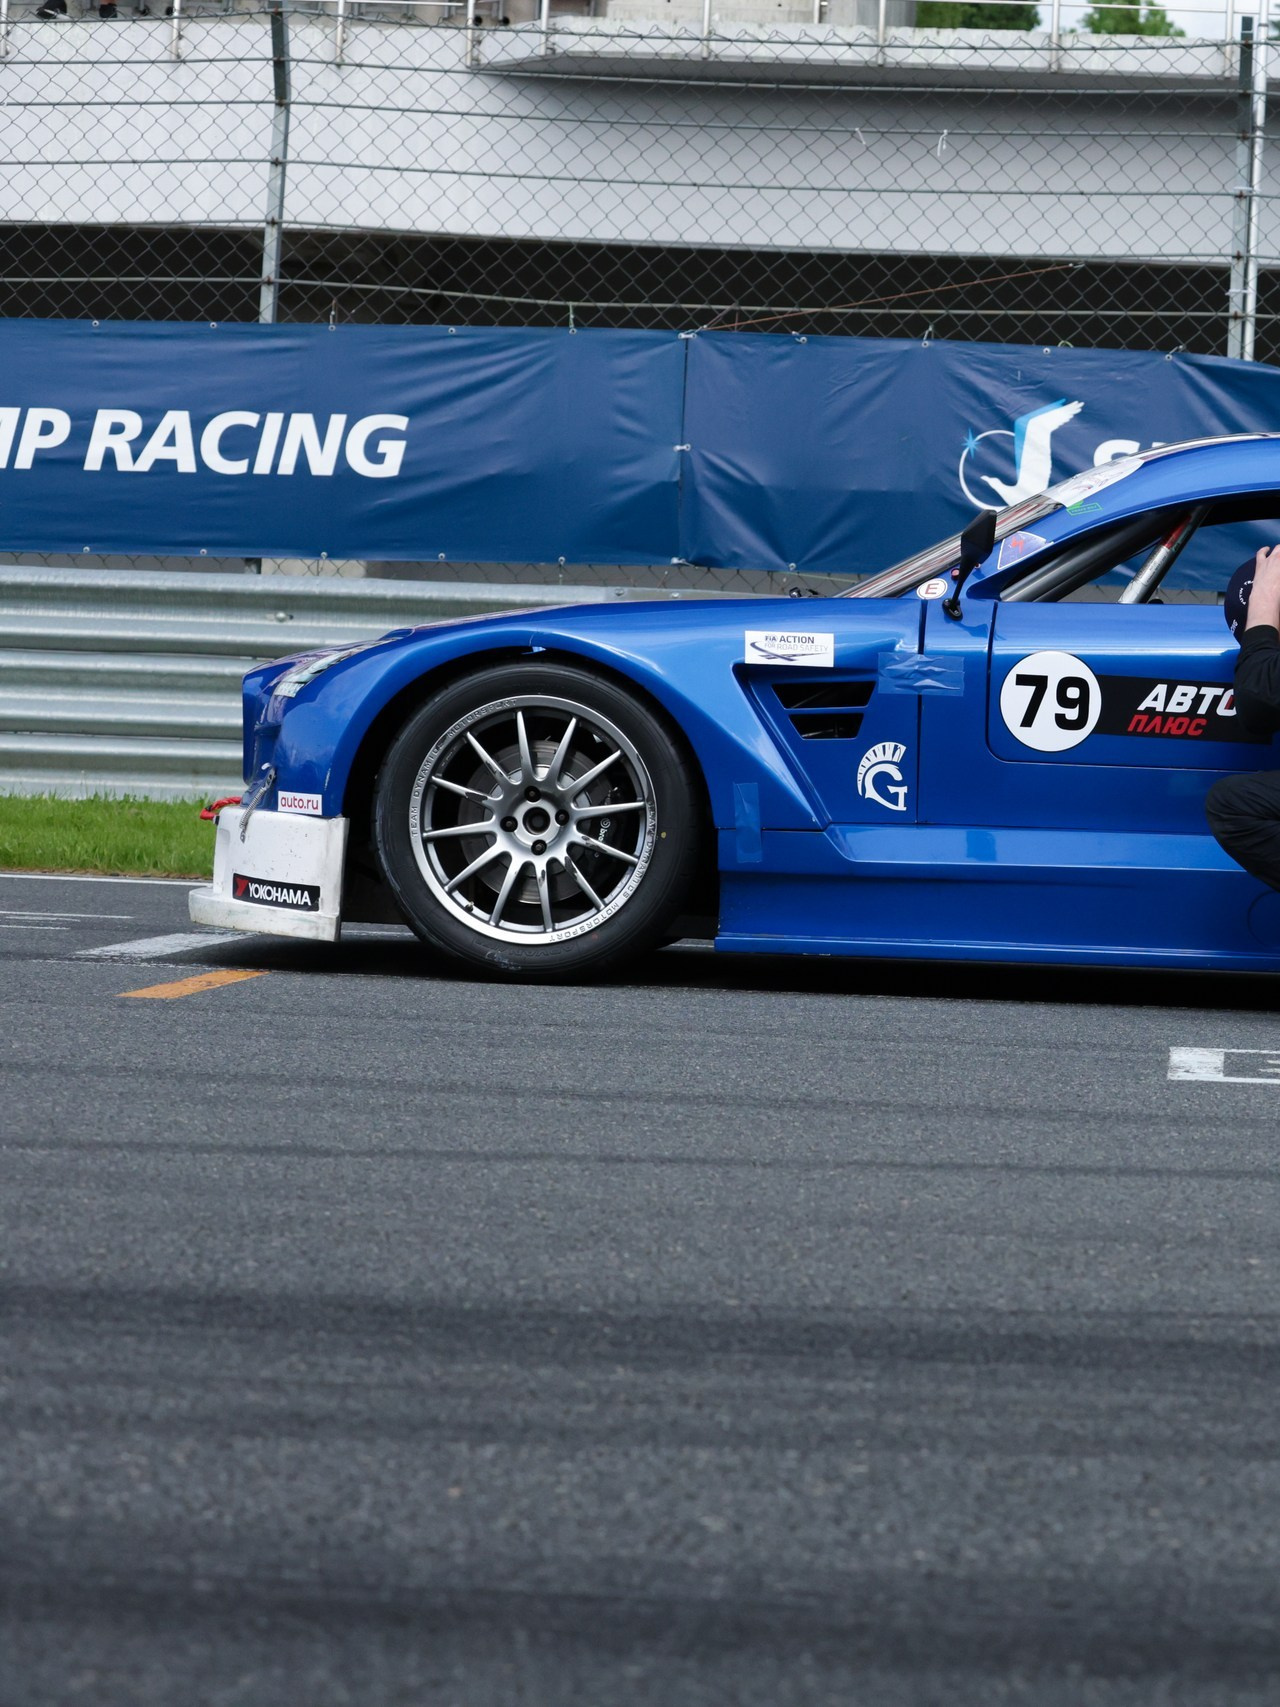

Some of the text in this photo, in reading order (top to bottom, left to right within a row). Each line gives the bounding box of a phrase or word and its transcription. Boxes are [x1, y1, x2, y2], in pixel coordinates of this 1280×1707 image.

[83, 409, 410, 478] RACING
[925, 582, 940, 595] E
[777, 643, 798, 651] ROAD
[800, 644, 829, 652] SAFETY
[779, 635, 815, 644] ACTION
[1015, 673, 1091, 731] 79
[1127, 714, 1208, 736] ПЛЮС
[280, 796, 319, 810] auto.ru
[410, 805, 419, 838] TEAM
[248, 882, 312, 906] YOKOHAMA
[549, 902, 620, 942] MOTORSPORT
